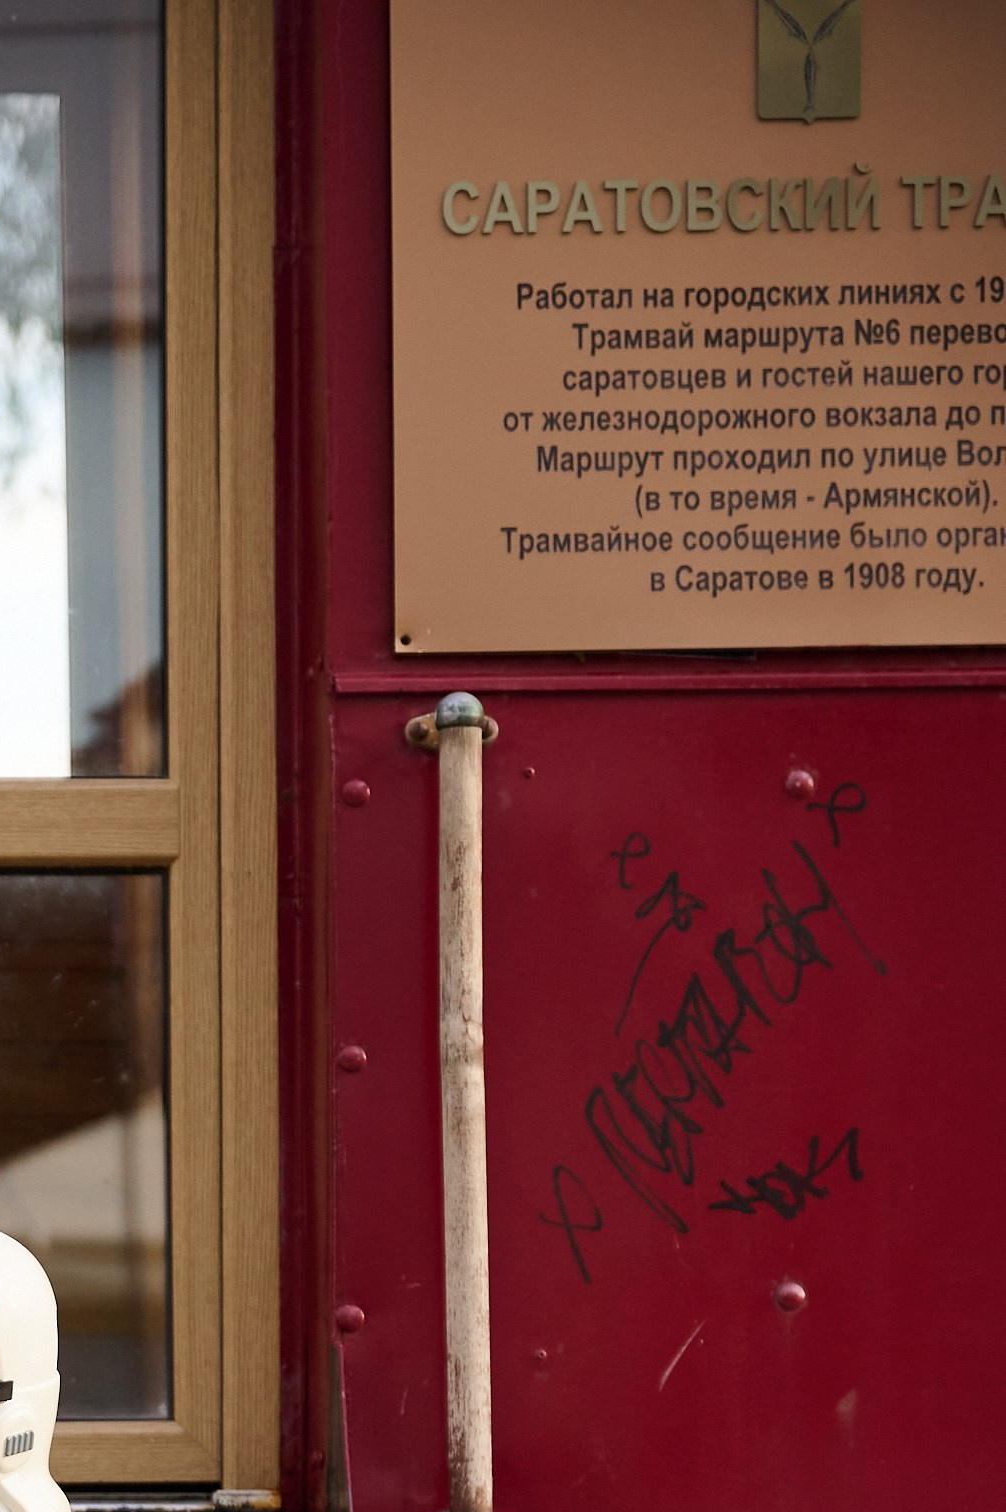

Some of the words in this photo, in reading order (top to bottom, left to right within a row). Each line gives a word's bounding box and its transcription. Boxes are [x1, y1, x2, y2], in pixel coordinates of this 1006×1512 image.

[442, 163, 881, 236] САРАТОВСКИЙ
[900, 174, 1006, 231] ТРА
[516, 281, 633, 311] Работал
[642, 287, 675, 309] на
[683, 285, 830, 315] городских
[837, 283, 942, 306] линиях
[949, 283, 965, 304] с
[974, 275, 1005, 304] 19
[571, 321, 694, 357] Трамвай
[703, 325, 845, 355] маршрута
[854, 318, 901, 346] №6
[910, 323, 1006, 352] перево
[562, 368, 727, 398] саратовцев
[736, 368, 752, 389] и
[761, 359, 853, 388] гостей
[863, 364, 964, 387] нашего
[502, 411, 534, 433] от
[541, 407, 817, 437] железнодорожного
[825, 406, 937, 428] вокзала
[944, 405, 982, 431] до
[536, 444, 665, 480] Маршрут
[673, 448, 811, 478] проходил
[820, 447, 854, 469] по
[862, 446, 947, 476] улице
[956, 439, 1006, 467] Вол
[635, 484, 661, 519] (в
[668, 490, 701, 512] то
[710, 489, 797, 517] время
[823, 479, 998, 516] Армянской).
[499, 525, 673, 561] Трамвайное
[682, 523, 841, 555] сообщение
[849, 521, 928, 549] было
[650, 571, 666, 593] в
[674, 564, 809, 599] Саратове
[818, 569, 834, 591] в
[844, 561, 906, 590] 1908
[915, 567, 984, 596] году.
